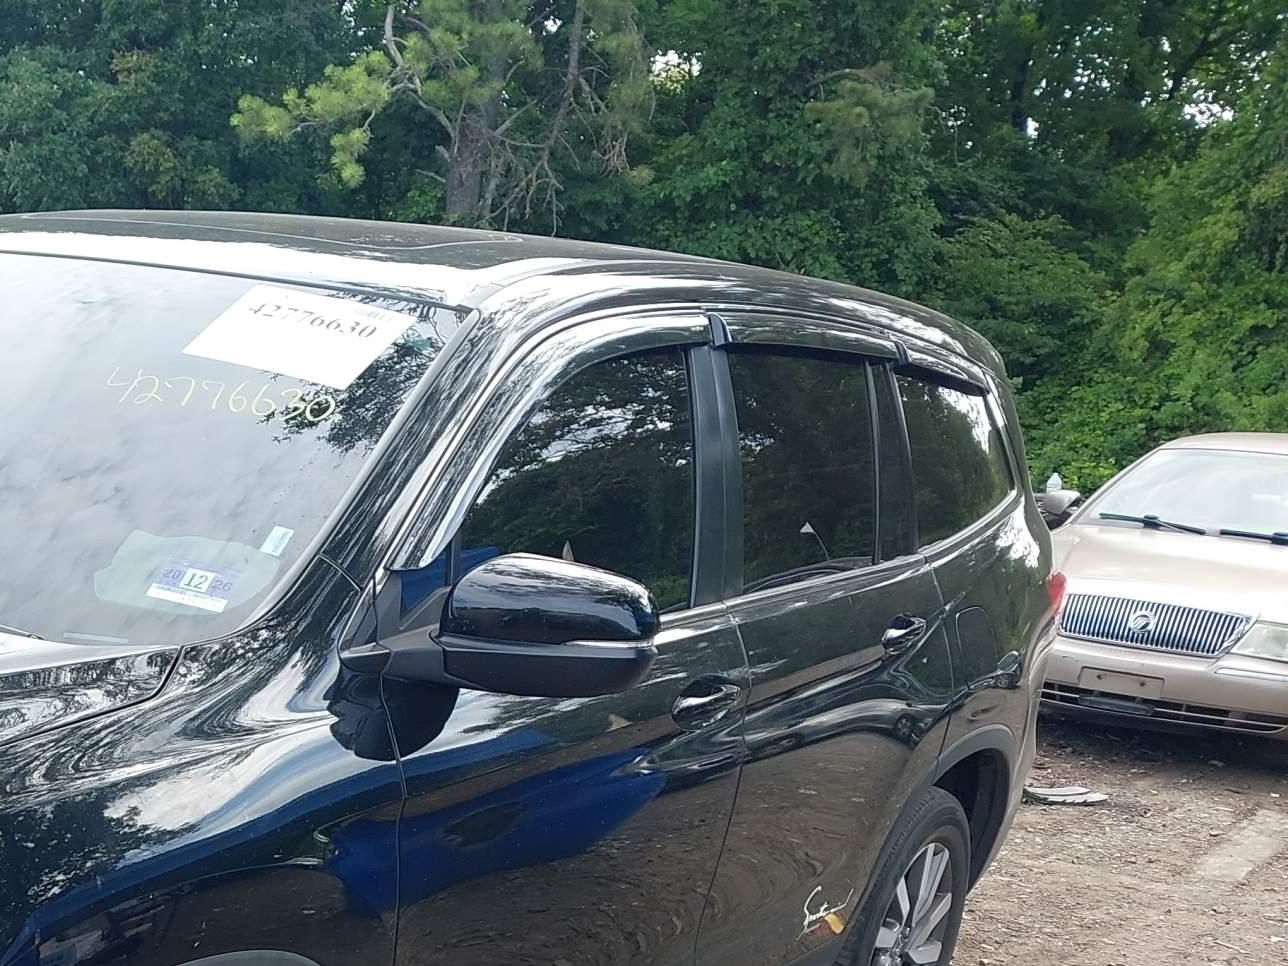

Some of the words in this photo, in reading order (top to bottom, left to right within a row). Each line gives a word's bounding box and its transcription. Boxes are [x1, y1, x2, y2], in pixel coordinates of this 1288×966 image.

[249, 302, 378, 339] 42776630
[106, 366, 337, 422] 42776630
[183, 572, 210, 590] 12
[212, 578, 233, 593] 26
